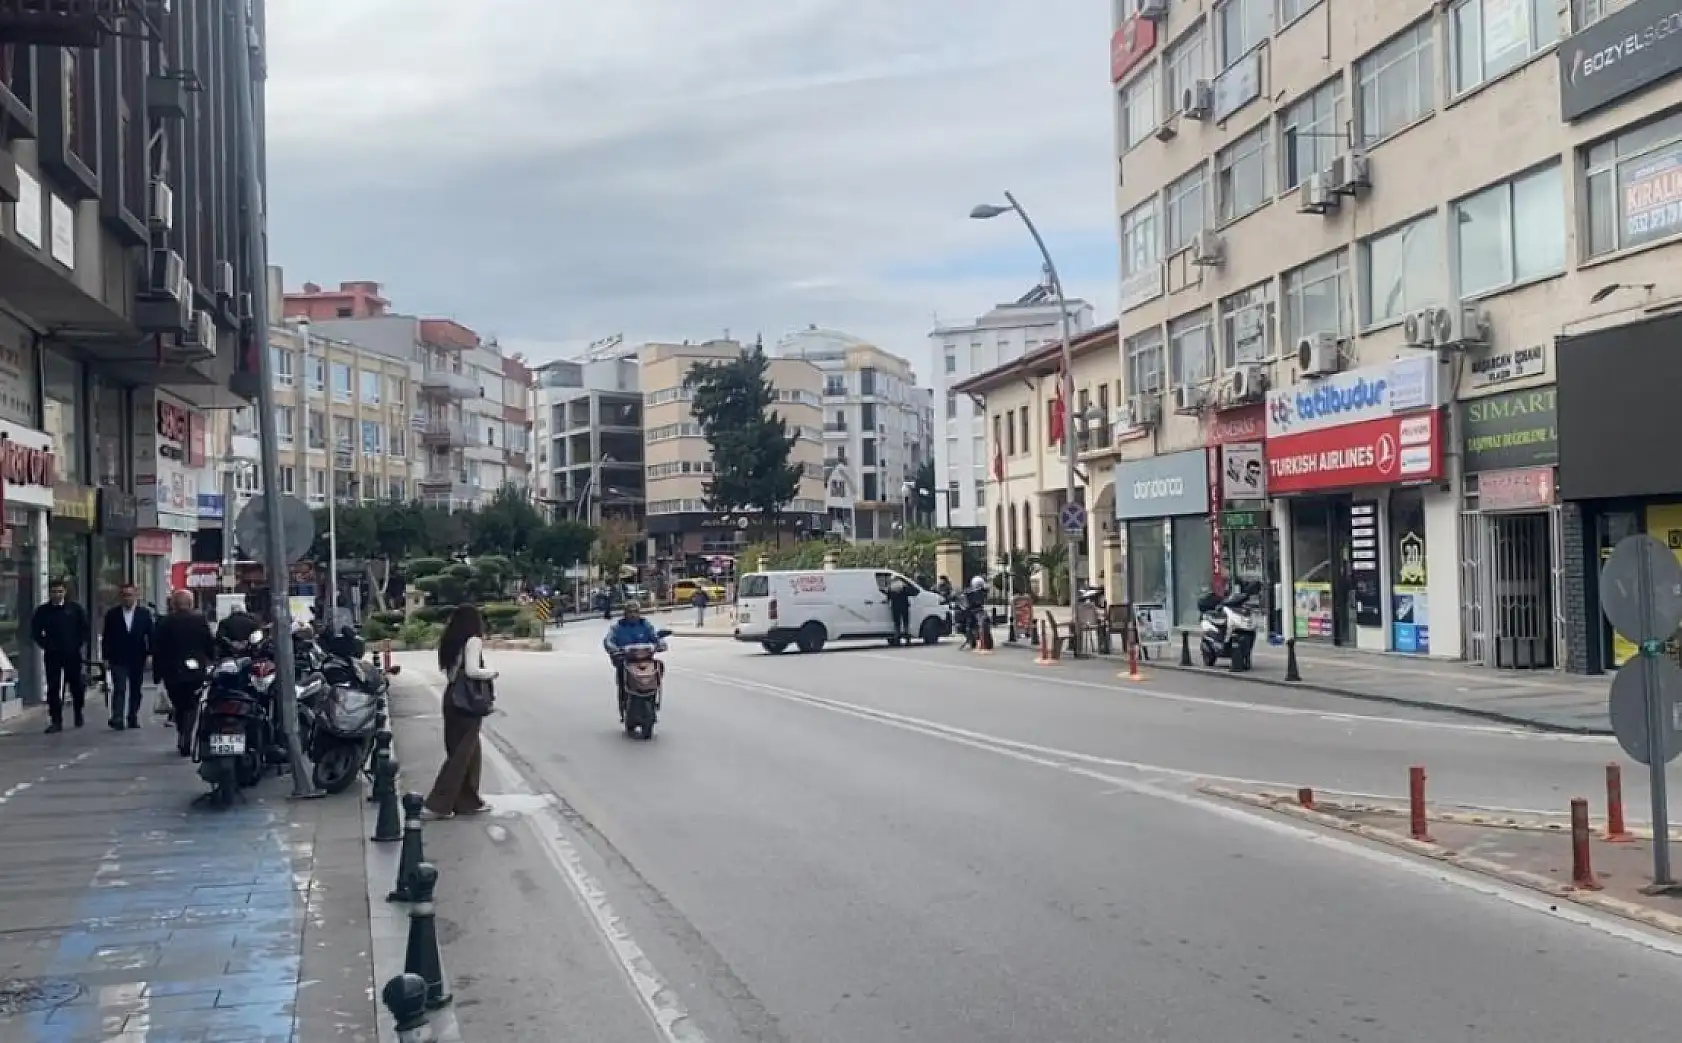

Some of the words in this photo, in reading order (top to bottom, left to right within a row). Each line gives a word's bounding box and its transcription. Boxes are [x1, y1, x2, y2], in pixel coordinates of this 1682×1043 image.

[1584, 33, 1644, 76] BOZYEL
[1296, 377, 1387, 420] tatilbudur
[1269, 452, 1318, 477] TURKISH
[1319, 447, 1374, 471] AIRLINES
